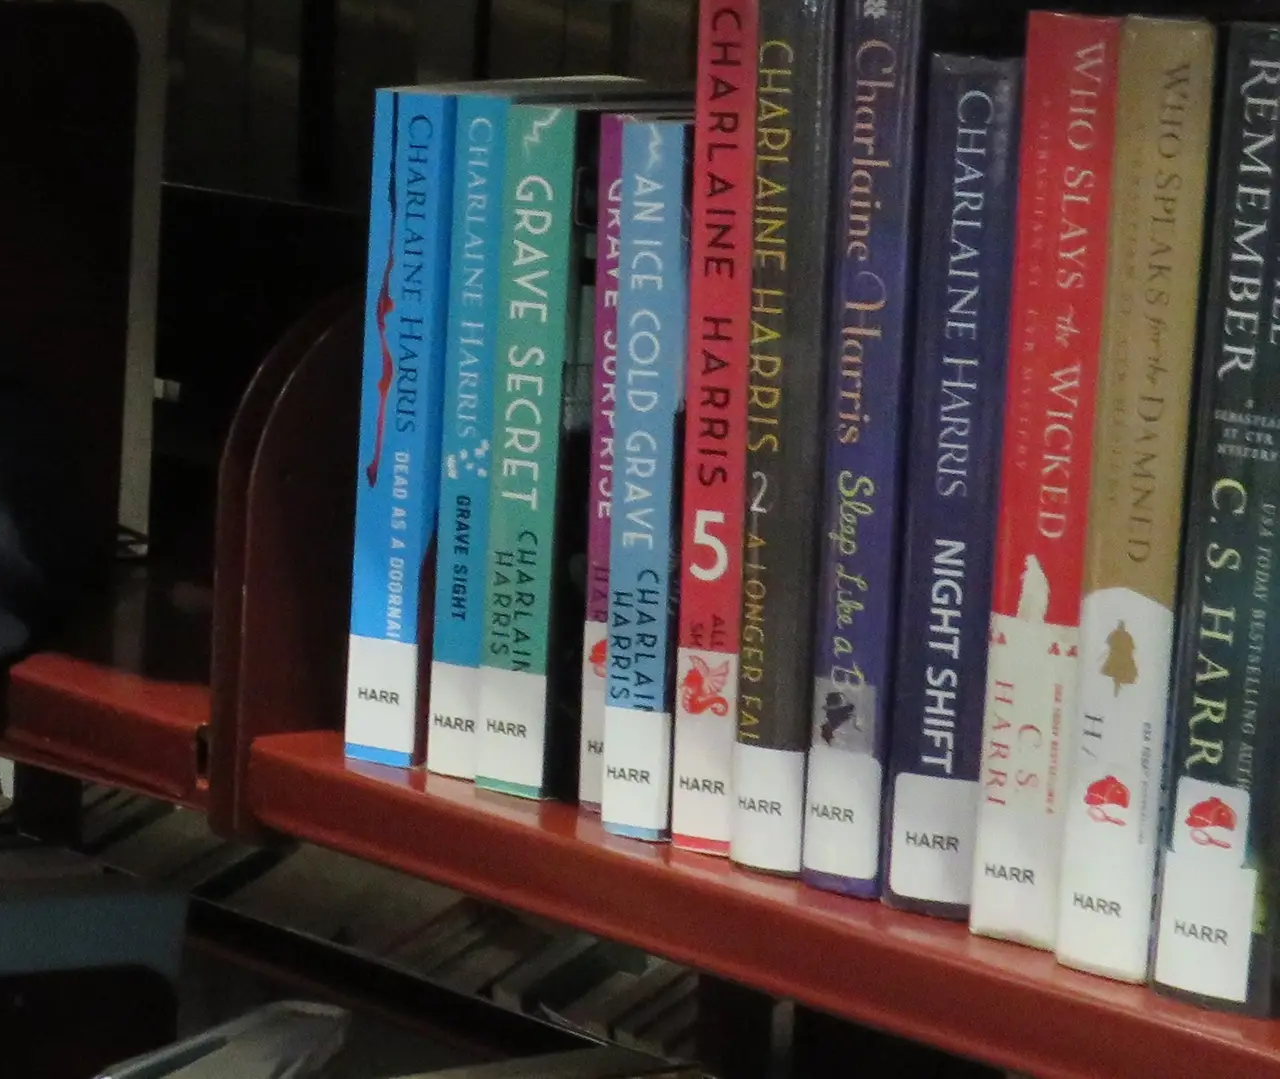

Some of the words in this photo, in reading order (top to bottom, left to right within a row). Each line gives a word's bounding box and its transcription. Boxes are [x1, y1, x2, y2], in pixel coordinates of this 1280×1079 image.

[704, 7, 741, 281] CHARLAINE
[1065, 41, 1108, 152] WHO
[1156, 61, 1191, 160] WHO
[632, 174, 664, 223] AN
[753, 39, 794, 272] CHARLAINE
[846, 38, 897, 262] Charlaine
[399, 114, 433, 309] CHARLAINE
[460, 117, 493, 306] CHARLAINE
[510, 174, 553, 324] GRAVE
[945, 89, 994, 341] CHARLAINE
[1055, 165, 1097, 291] SLAYS
[1144, 166, 1183, 310] SPEAKS
[1217, 57, 1280, 381] REMEMBER
[630, 240, 663, 291] ICE
[394, 313, 429, 434] HARRIS
[625, 309, 660, 413] COLD
[747, 294, 784, 455] HARRIS
[837, 270, 888, 444] Harris
[1055, 306, 1080, 348] the
[455, 322, 486, 439] HARRIS
[501, 344, 545, 512] SECRET
[696, 317, 733, 487] HARRIS
[938, 355, 980, 498] HARRIS
[393, 450, 410, 500] DEAD
[622, 429, 658, 551] GRAVE
[1040, 364, 1082, 539] WICKED
[1126, 395, 1165, 565] DAMNED
[1209, 476, 1248, 524] C.
[390, 537, 406, 550] A
[391, 506, 407, 531] AS
[454, 495, 472, 556] GRAVE
[688, 509, 730, 582] 5
[827, 469, 877, 556] Sleep
[1258, 502, 1278, 539] USA
[451, 563, 468, 621] SIGHT
[490, 550, 514, 656] HARRIS
[835, 562, 869, 629] Like
[929, 537, 966, 656] NIGHT
[1203, 541, 1241, 584] S.
[1252, 544, 1273, 601] TODAY
[610, 588, 635, 700] HARRIS
[832, 635, 853, 659] a
[1241, 608, 1265, 735] BESTSELLING
[358, 686, 400, 706] HARR
[434, 713, 476, 733] HARR
[486, 718, 527, 739] HARR
[920, 659, 960, 775] SHIFT
[606, 765, 651, 785] HARR
[679, 776, 725, 796] HARR
[738, 796, 782, 816] HARR
[810, 803, 854, 824] HARR
[905, 830, 960, 853] HARR
[984, 862, 1035, 886] HARR
[1072, 891, 1122, 918] HARR
[1174, 919, 1230, 946] HARR
